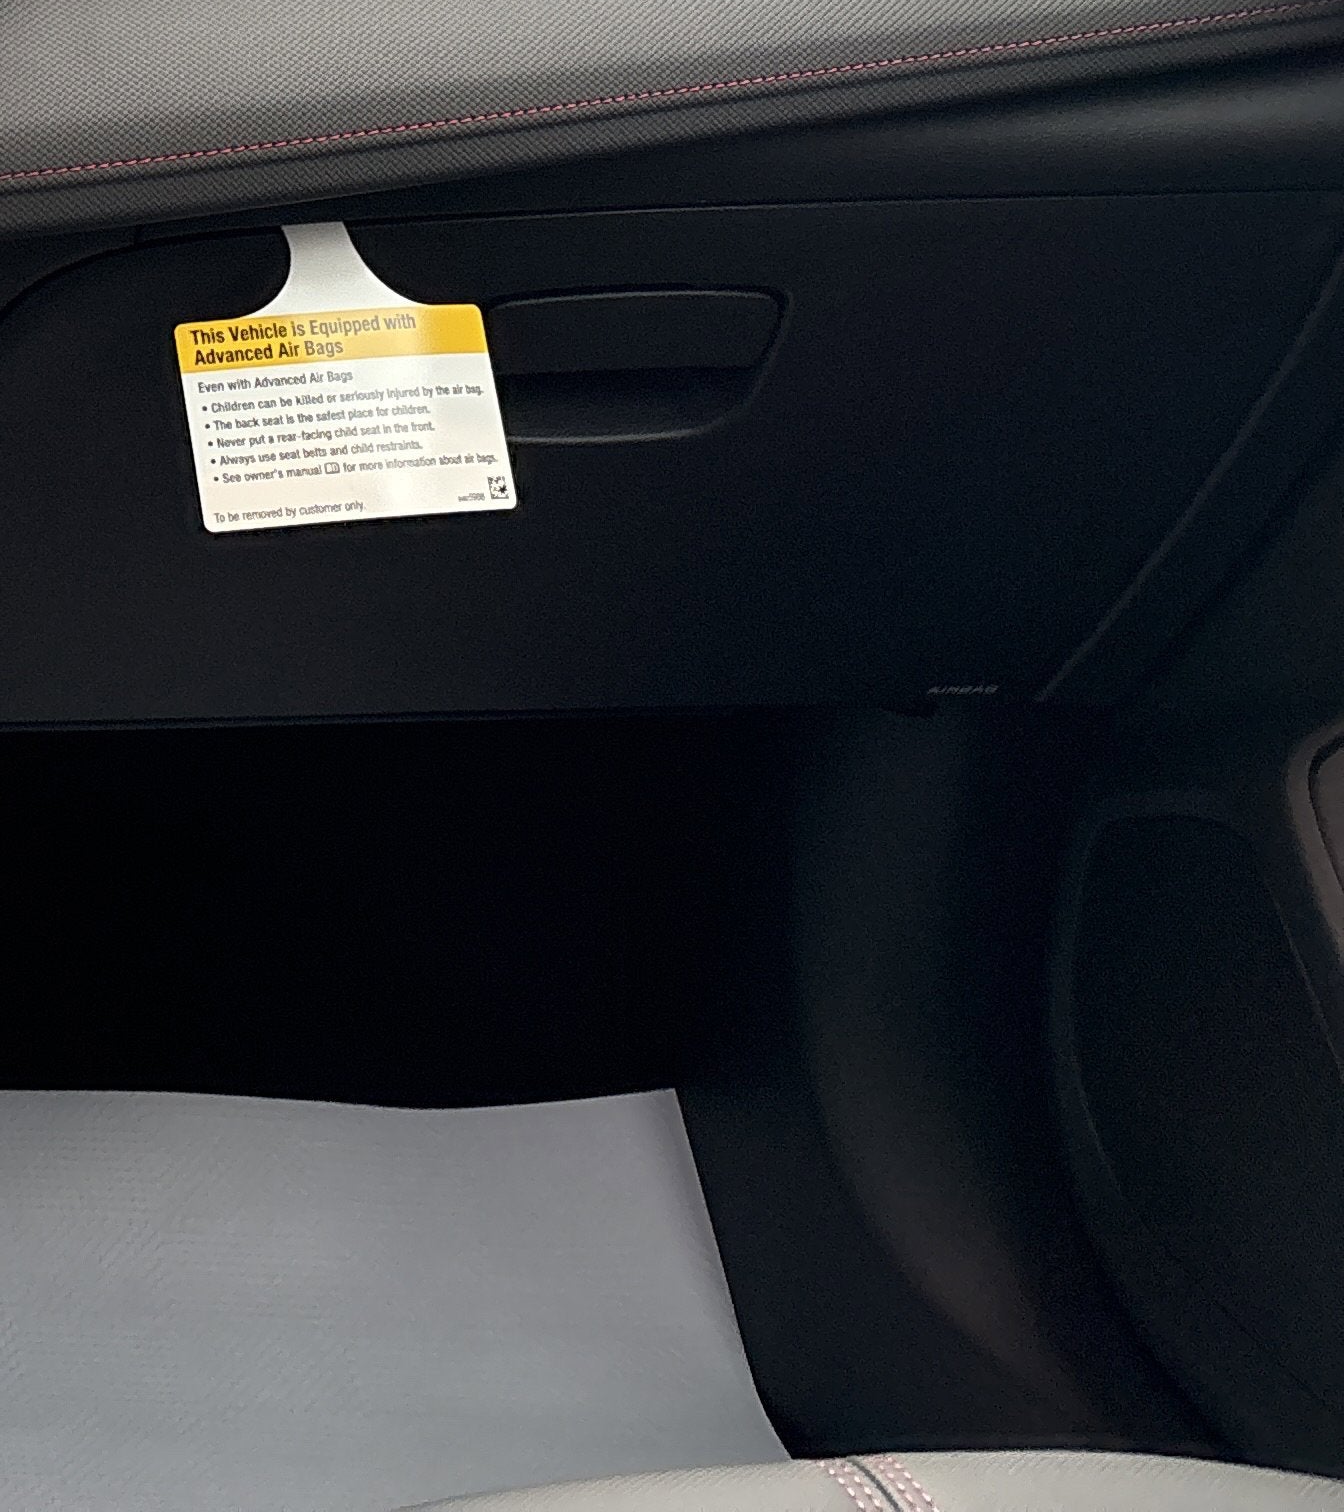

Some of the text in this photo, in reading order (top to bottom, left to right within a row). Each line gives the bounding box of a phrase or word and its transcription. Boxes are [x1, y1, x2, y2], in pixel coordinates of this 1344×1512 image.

[190, 314, 416, 345] This Vehicle is Equipped with
[195, 340, 344, 365] Advanced Air Bags
[198, 370, 354, 393] Even with Advanced Air Bags
[212, 400, 255, 413] Children
[258, 399, 277, 409] can
[280, 396, 293, 407] be
[295, 393, 324, 406] killed
[327, 393, 337, 403] or
[340, 389, 384, 402] seriously
[387, 387, 420, 400] injured
[422, 387, 433, 398] by
[435, 385, 450, 395] the
[453, 384, 463, 394] air
[213, 404, 431, 431] The back seat is the safest place for children.
[217, 436, 246, 449] Never
[249, 434, 265, 448] put
[277, 429, 332, 443] rear-facing
[334, 426, 358, 438] child
[361, 425, 381, 436] seat
[383, 423, 392, 434] in
[394, 422, 408, 433] the
[220, 439, 423, 466] Always use seat belts and child restraints.
[222, 472, 241, 484] See
[244, 468, 284, 481] owner's
[286, 464, 323, 478] manual
[343, 462, 356, 473] for
[359, 460, 383, 472] more
[385, 456, 436, 470] information
[213, 512, 225, 523] To
[228, 510, 239, 522] be
[242, 507, 283, 520] removed
[285, 506, 296, 518] by
[299, 502, 342, 515] customer
